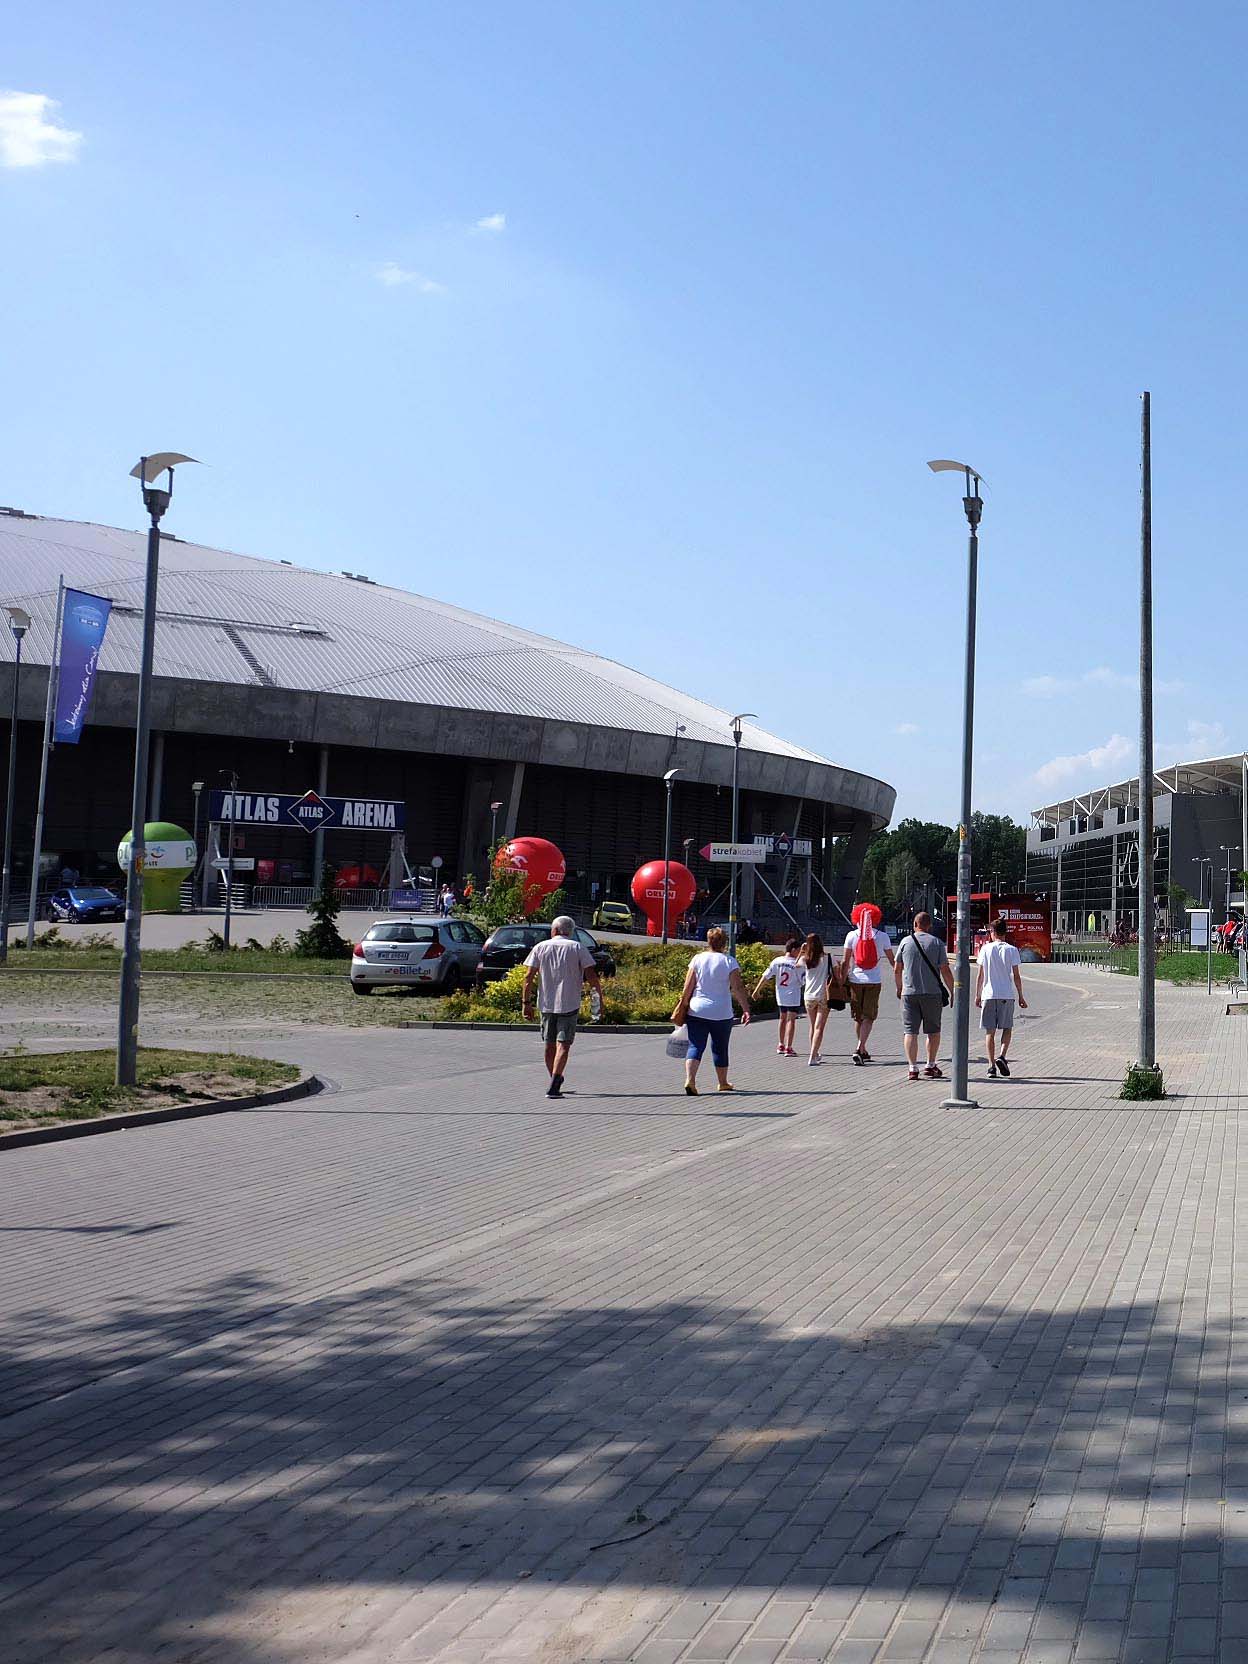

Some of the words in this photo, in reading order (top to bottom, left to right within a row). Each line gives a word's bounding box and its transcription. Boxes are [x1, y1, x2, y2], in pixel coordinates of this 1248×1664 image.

[220, 794, 280, 822] ATLAS
[341, 801, 396, 828] ARENA
[298, 806, 323, 819] ATLAS
[780, 972, 790, 987] 2
